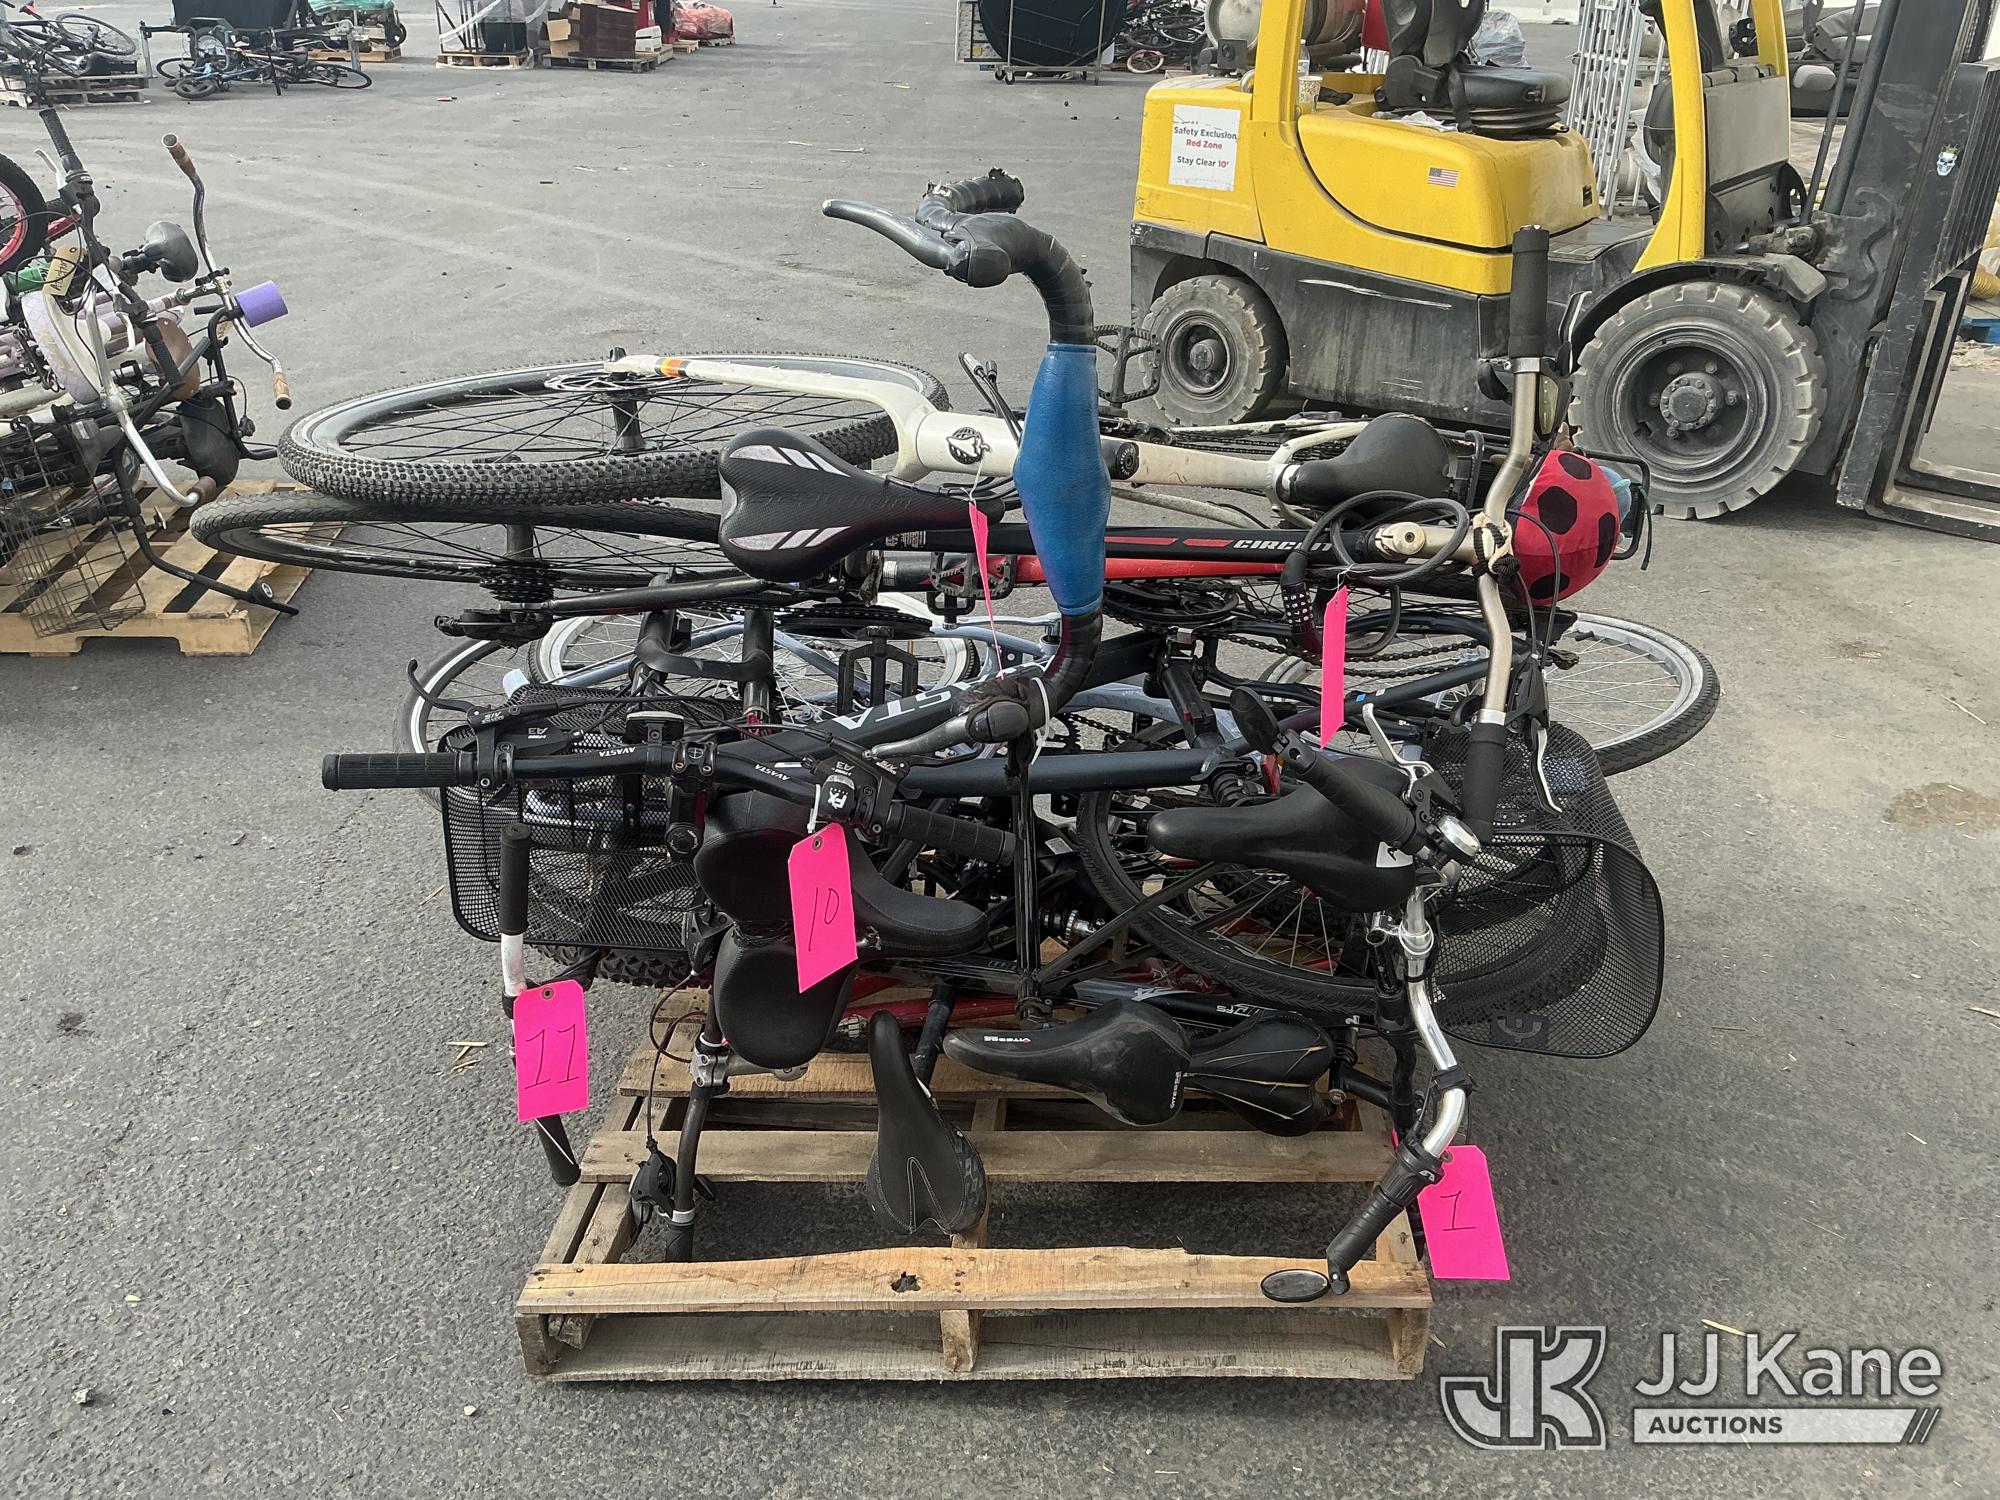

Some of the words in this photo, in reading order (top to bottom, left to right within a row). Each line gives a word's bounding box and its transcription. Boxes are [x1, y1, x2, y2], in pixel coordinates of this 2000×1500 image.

[1173, 126, 1199, 137] Safety
[1200, 129, 1238, 140] Exclusion
[1186, 138, 1201, 148] Red
[1202, 140, 1223, 150] Zone
[1176, 155, 1194, 166] Stay
[1195, 158, 1216, 167] Clear
[599, 746, 637, 758] AVASTA
[754, 763, 791, 782] AVASTA
[807, 887, 841, 952] 10
[523, 1023, 581, 1091] 11
